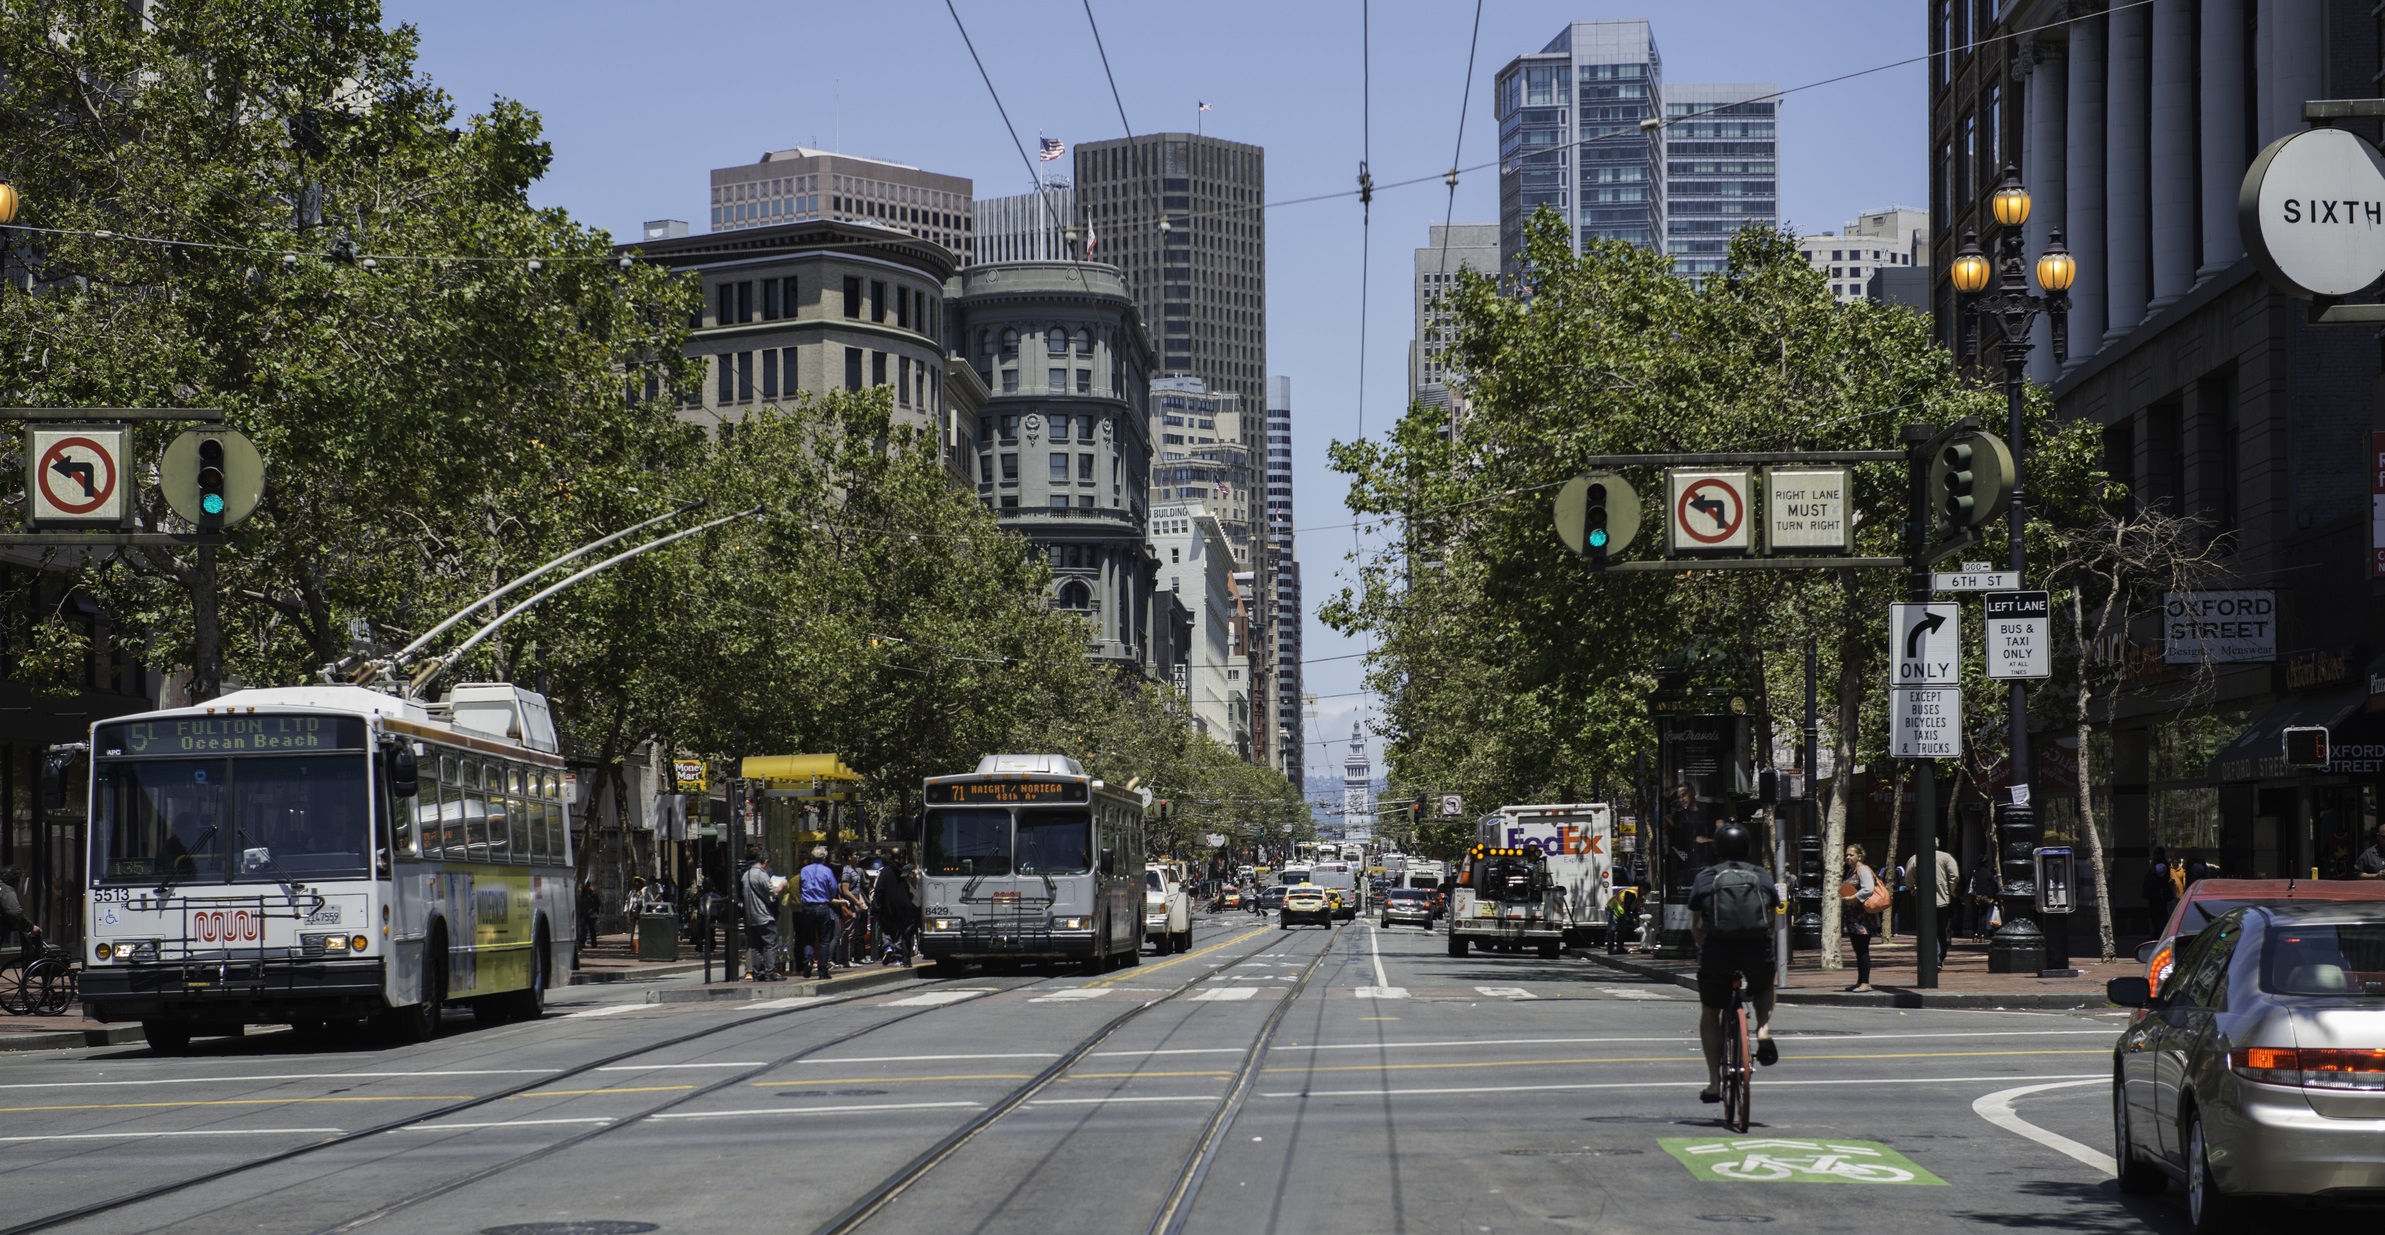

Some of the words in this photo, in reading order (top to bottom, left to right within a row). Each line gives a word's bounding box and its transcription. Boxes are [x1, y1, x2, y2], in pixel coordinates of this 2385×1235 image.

[2283, 198, 2382, 225] SIXTH
[1775, 490, 1805, 500] RIGHT
[1812, 489, 1840, 500] LANE
[1153, 507, 1188, 519] BUILDING
[1787, 503, 1828, 517] MUST
[1776, 521, 1803, 531] TURN
[1810, 520, 1840, 530] RIGHT
[1952, 576, 1977, 587] 6TH
[1987, 575, 2003, 586] ST
[1988, 601, 2014, 612] LEFT
[2017, 600, 2046, 611] LANE
[2166, 598, 2272, 617] OXFORD
[2000, 624, 2023, 634] BUS
[2026, 624, 2034, 634] &
[2169, 621, 2269, 640] STREET
[2005, 636, 2029, 647] TAXI
[2003, 649, 2033, 659] ONLY
[2221, 644, 2273, 655] Menswear
[1900, 662, 1950, 679] ONLY
[2370, 672, 2385, 695] Pizz
[1909, 691, 1942, 702] EXCEPT
[1911, 704, 1940, 715] BUSES
[176, 719, 263, 736] FULTON
[279, 717, 320, 733] LTD
[1905, 717, 1947, 728] BICYCLES
[181, 736, 245, 750] Ocean
[254, 732, 319, 749] Beach
[1913, 730, 1938, 741] TAXIS
[1902, 743, 1909, 753] &
[1917, 743, 1950, 754] TRUCKS
[2329, 744, 2385, 758] XFORD
[675, 762, 704, 773] Money
[2221, 759, 2251, 781] OXFORD
[677, 771, 702, 780] Mart
[951, 785, 965, 801] 71
[971, 784, 1006, 794] HAIGHT
[1011, 785, 1017, 793] /
[1020, 783, 1063, 793] NORIEGA
[1507, 826, 1604, 857] FedEx
[94, 888, 130, 902] 5513
[925, 907, 949, 916] 8429
